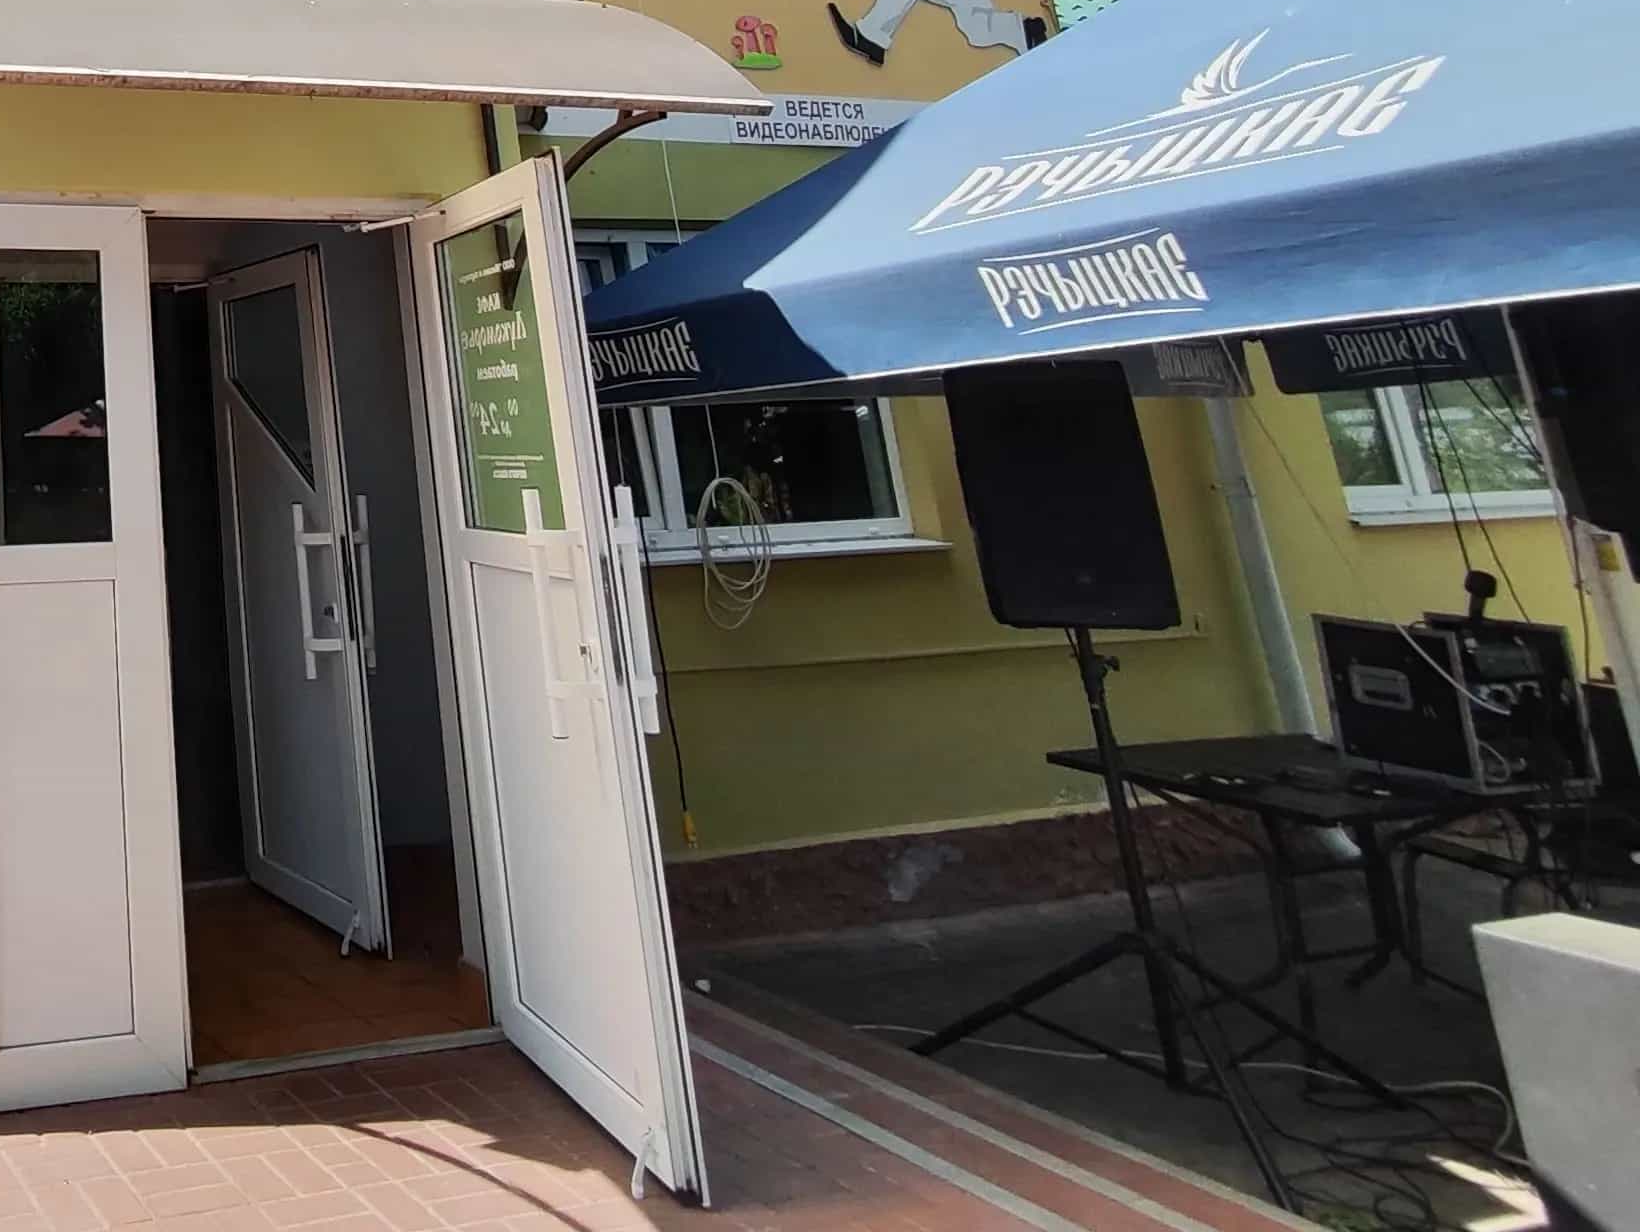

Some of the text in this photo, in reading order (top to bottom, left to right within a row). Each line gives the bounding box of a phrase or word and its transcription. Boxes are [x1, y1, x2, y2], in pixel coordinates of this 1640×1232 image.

[785, 99, 865, 120] ВЕДЕТСЯ
[736, 121, 886, 144] ВИДЕОНАБЛЮДЕ
[588, 321, 701, 381] ЭЧЫЦКАЕ
